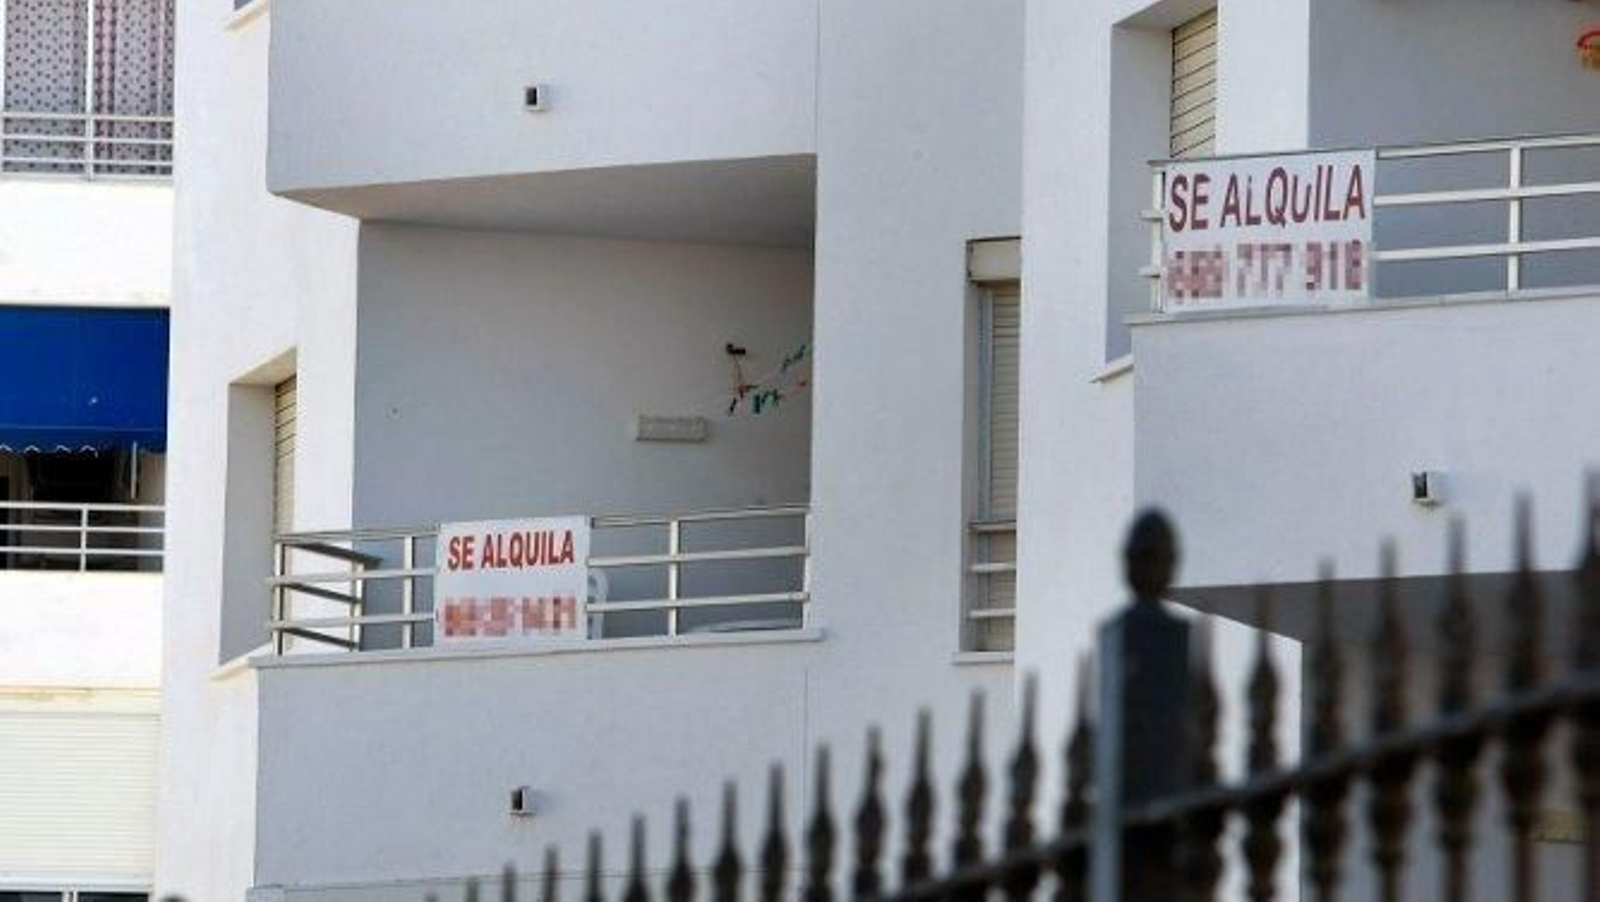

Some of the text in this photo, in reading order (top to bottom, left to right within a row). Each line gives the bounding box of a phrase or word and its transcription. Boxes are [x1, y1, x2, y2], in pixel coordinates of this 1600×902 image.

[1169, 173, 1211, 232] SE
[447, 530, 575, 571] SE ALQUILA
